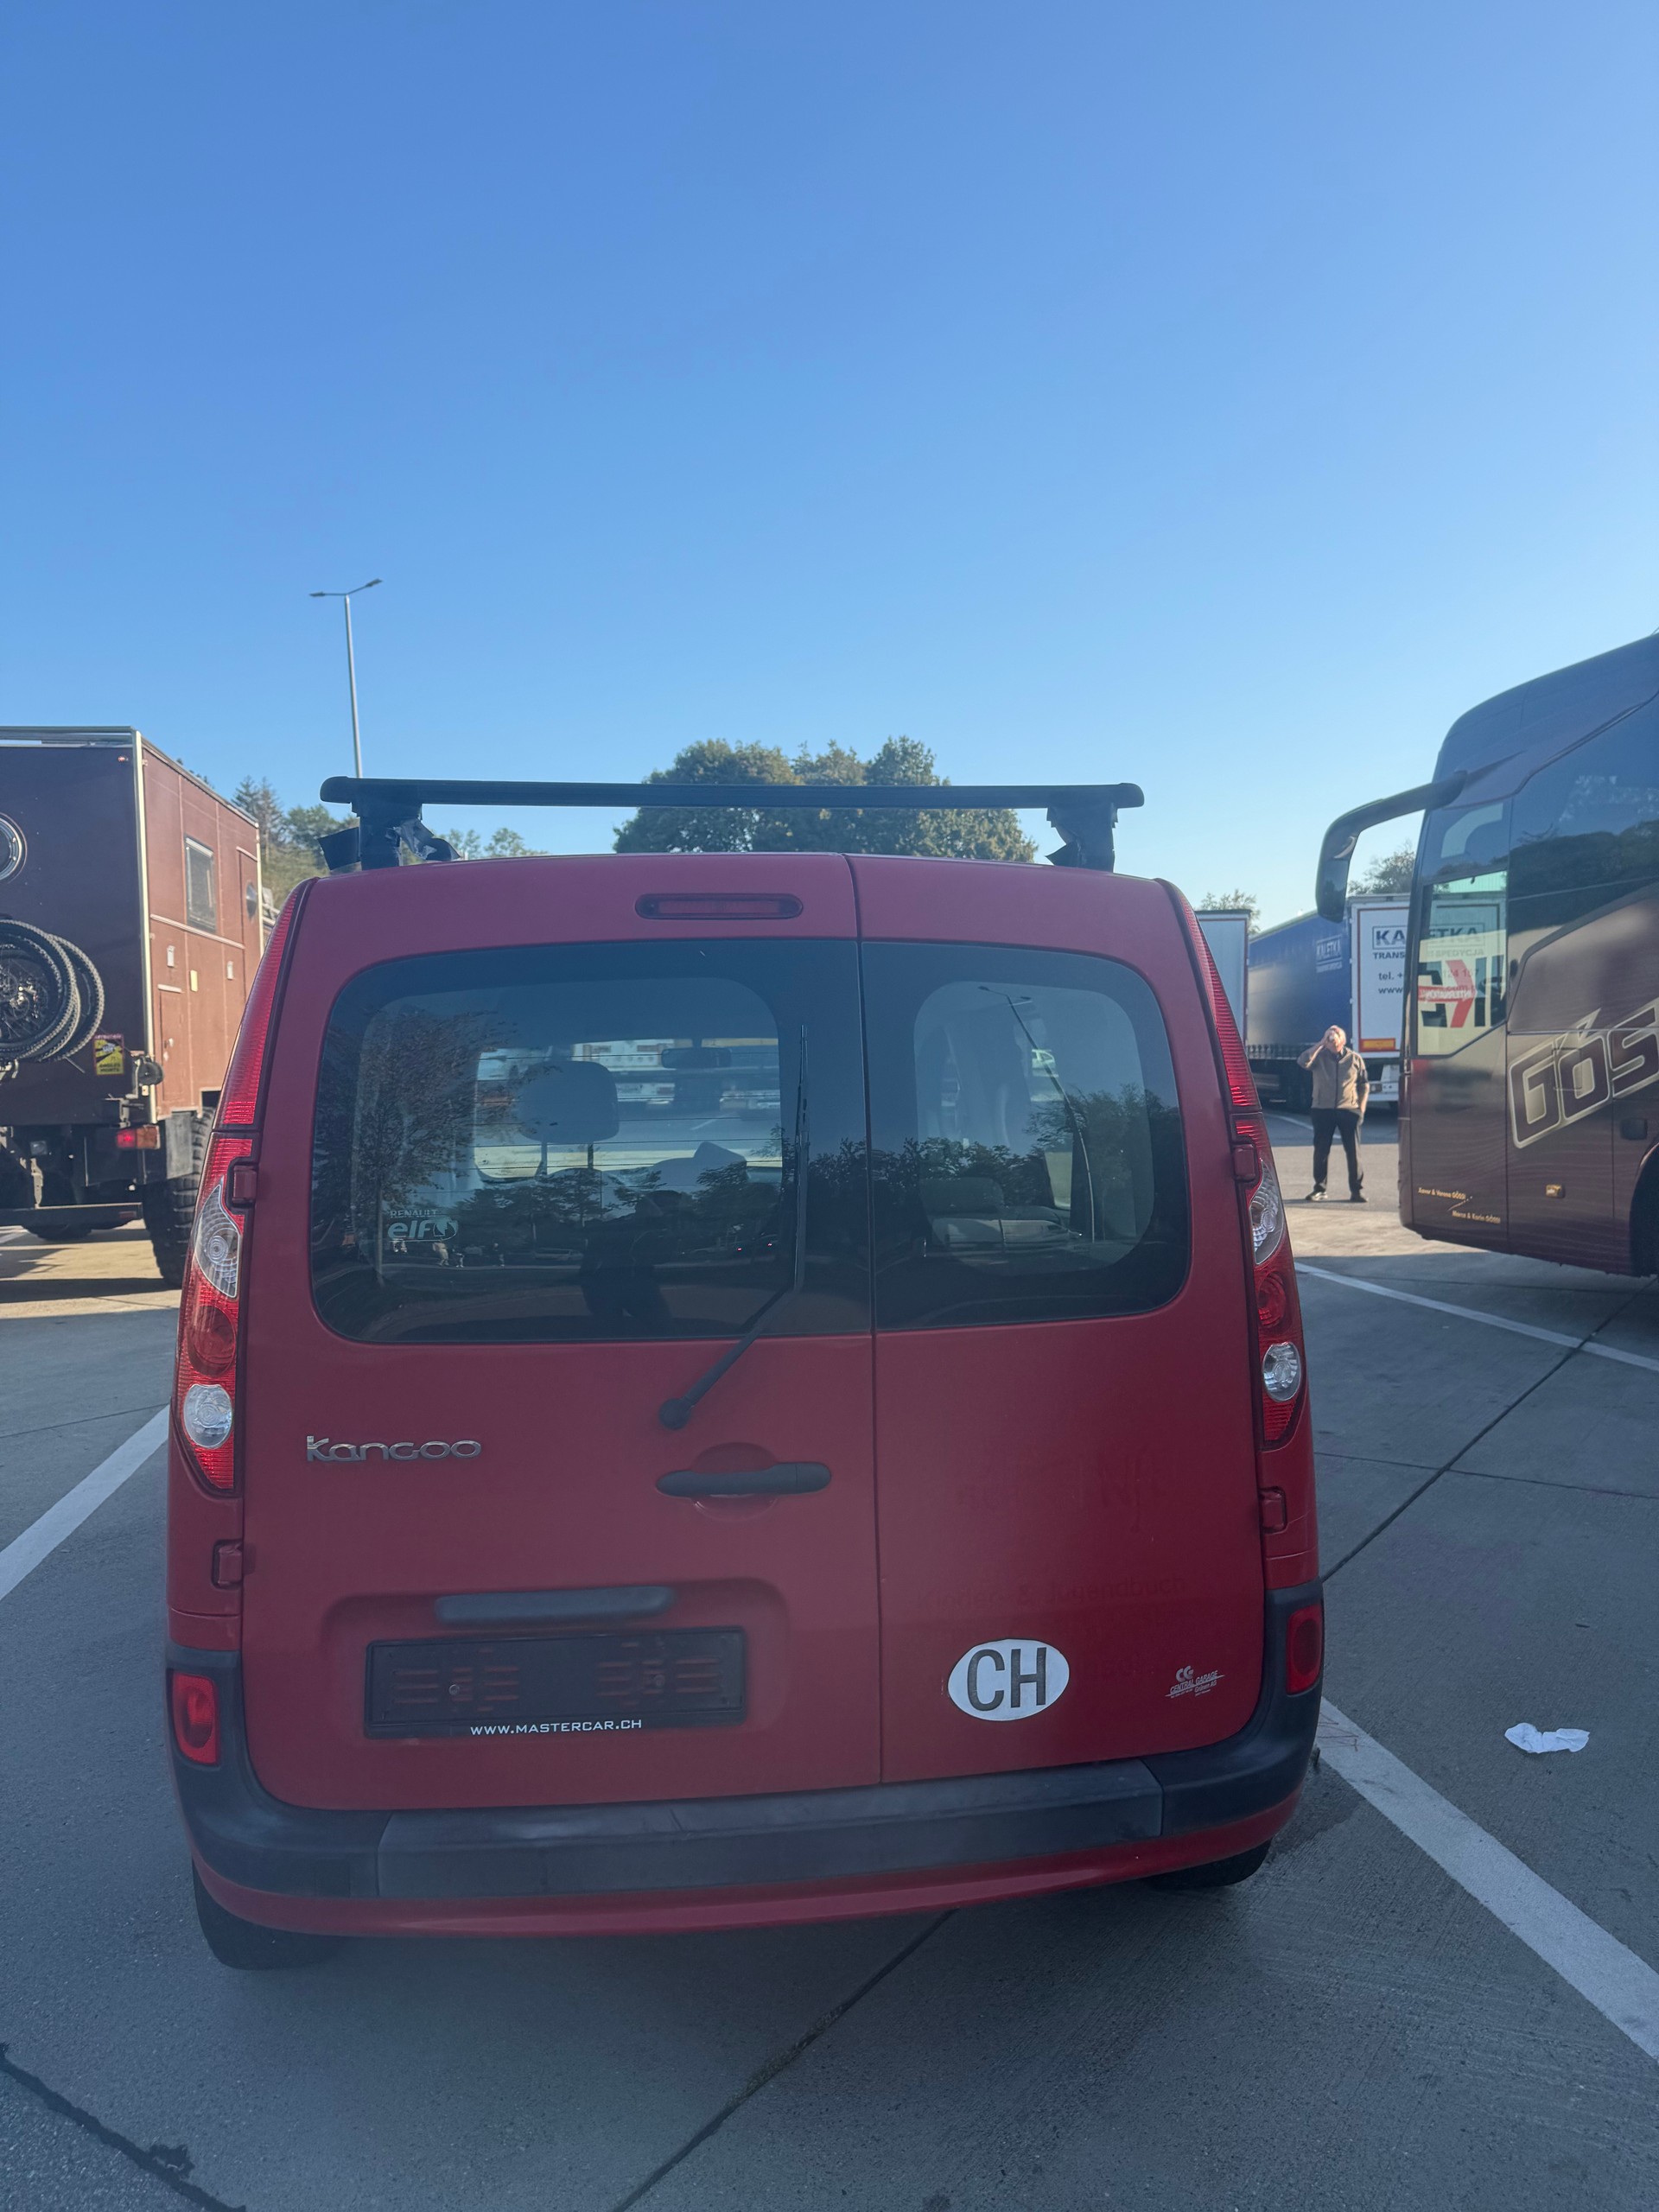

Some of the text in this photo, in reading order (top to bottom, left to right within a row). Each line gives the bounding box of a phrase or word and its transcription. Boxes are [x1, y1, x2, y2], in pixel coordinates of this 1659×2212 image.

[1378, 971, 1395, 981] tel.
[390, 1209, 437, 1218] RENAULT
[387, 1219, 433, 1239] elf
[966, 1647, 1047, 1712] CH
[1170, 1679, 1194, 1694] CENTRAL
[1195, 1669, 1218, 1685] GARAGE
[470, 1719, 642, 1735] WWW.MASTERCAR.CH
